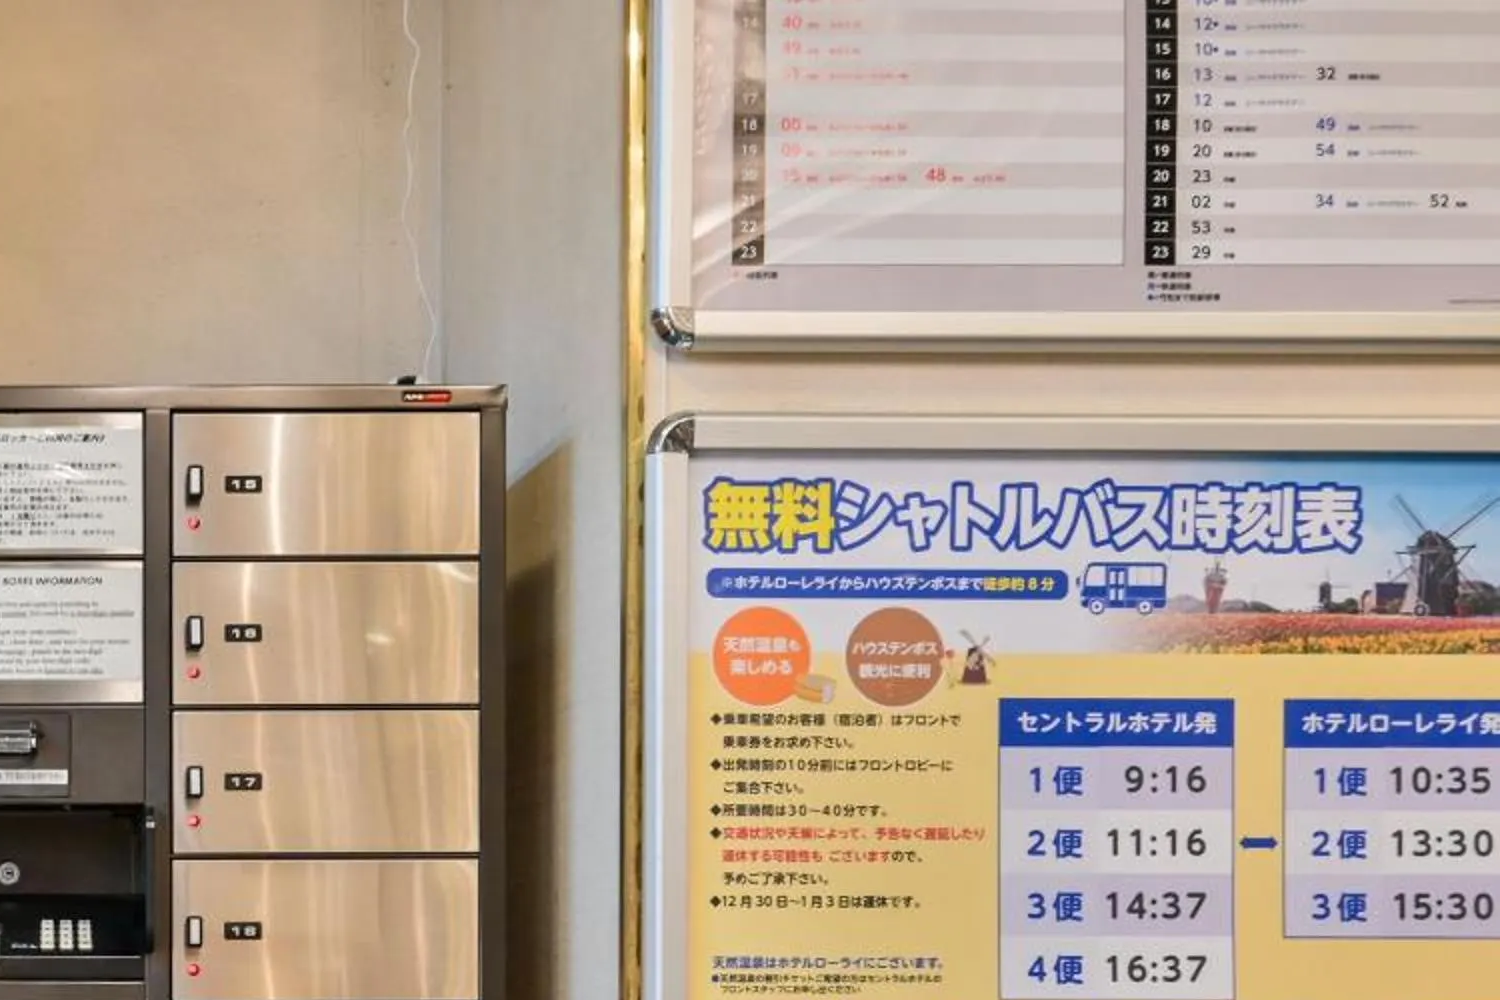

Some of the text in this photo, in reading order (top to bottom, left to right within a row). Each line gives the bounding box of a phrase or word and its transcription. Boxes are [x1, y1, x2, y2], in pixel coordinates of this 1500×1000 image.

[1155, 18, 1170, 30] 14
[1194, 18, 1212, 30] 12
[1155, 43, 1170, 55] 15
[1194, 43, 1212, 55] 10
[1155, 68, 1170, 80] 16
[1194, 68, 1213, 81] 13
[1316, 67, 1336, 80] 32
[1155, 94, 1170, 106] 17
[1194, 94, 1212, 106] 12
[1155, 119, 1170, 131] 18
[1193, 119, 1212, 132] 10
[1316, 118, 1335, 131] 49
[1155, 145, 1170, 156] 19
[1193, 145, 1212, 157] 20
[1316, 144, 1335, 156] 54
[925, 168, 945, 182] 48
[1153, 170, 1169, 181] 20
[1193, 170, 1211, 183] 23
[1153, 196, 1169, 207] 21
[1192, 196, 1210, 208] 02
[1316, 194, 1333, 207] 34
[1430, 194, 1449, 207] 52
[740, 221, 757, 233] 22
[1153, 221, 1169, 233] 22
[1192, 221, 1211, 234] 53
[740, 247, 757, 258] 23
[1153, 247, 1169, 258] 23
[1192, 247, 1211, 259] 29
[231, 479, 257, 490] 15
[703, 476, 1363, 554] 無料シャトルバス時刻表
[35, 576, 103, 586] INFORMATION
[231, 627, 257, 639] 16
[852, 641, 939, 657] ハウステンボス
[730, 659, 793, 676] 楽しめる
[858, 663, 931, 680] 観光に便利
[1017, 711, 1218, 735] セントラルホテル発
[1301, 711, 1500, 735] ホテルローレライ発
[231, 776, 257, 788] 17
[1029, 765, 1208, 796] 1便 9:16
[1314, 766, 1491, 797] 1便 10:35
[1027, 828, 1208, 859] 2便 11:16
[1312, 829, 1494, 859] 2便 13:30
[1027, 891, 1208, 922] 3便 14:37
[1312, 892, 1494, 923] 3便 15:30
[231, 925, 257, 937] 18
[1028, 955, 1208, 986] 4便 16:37
